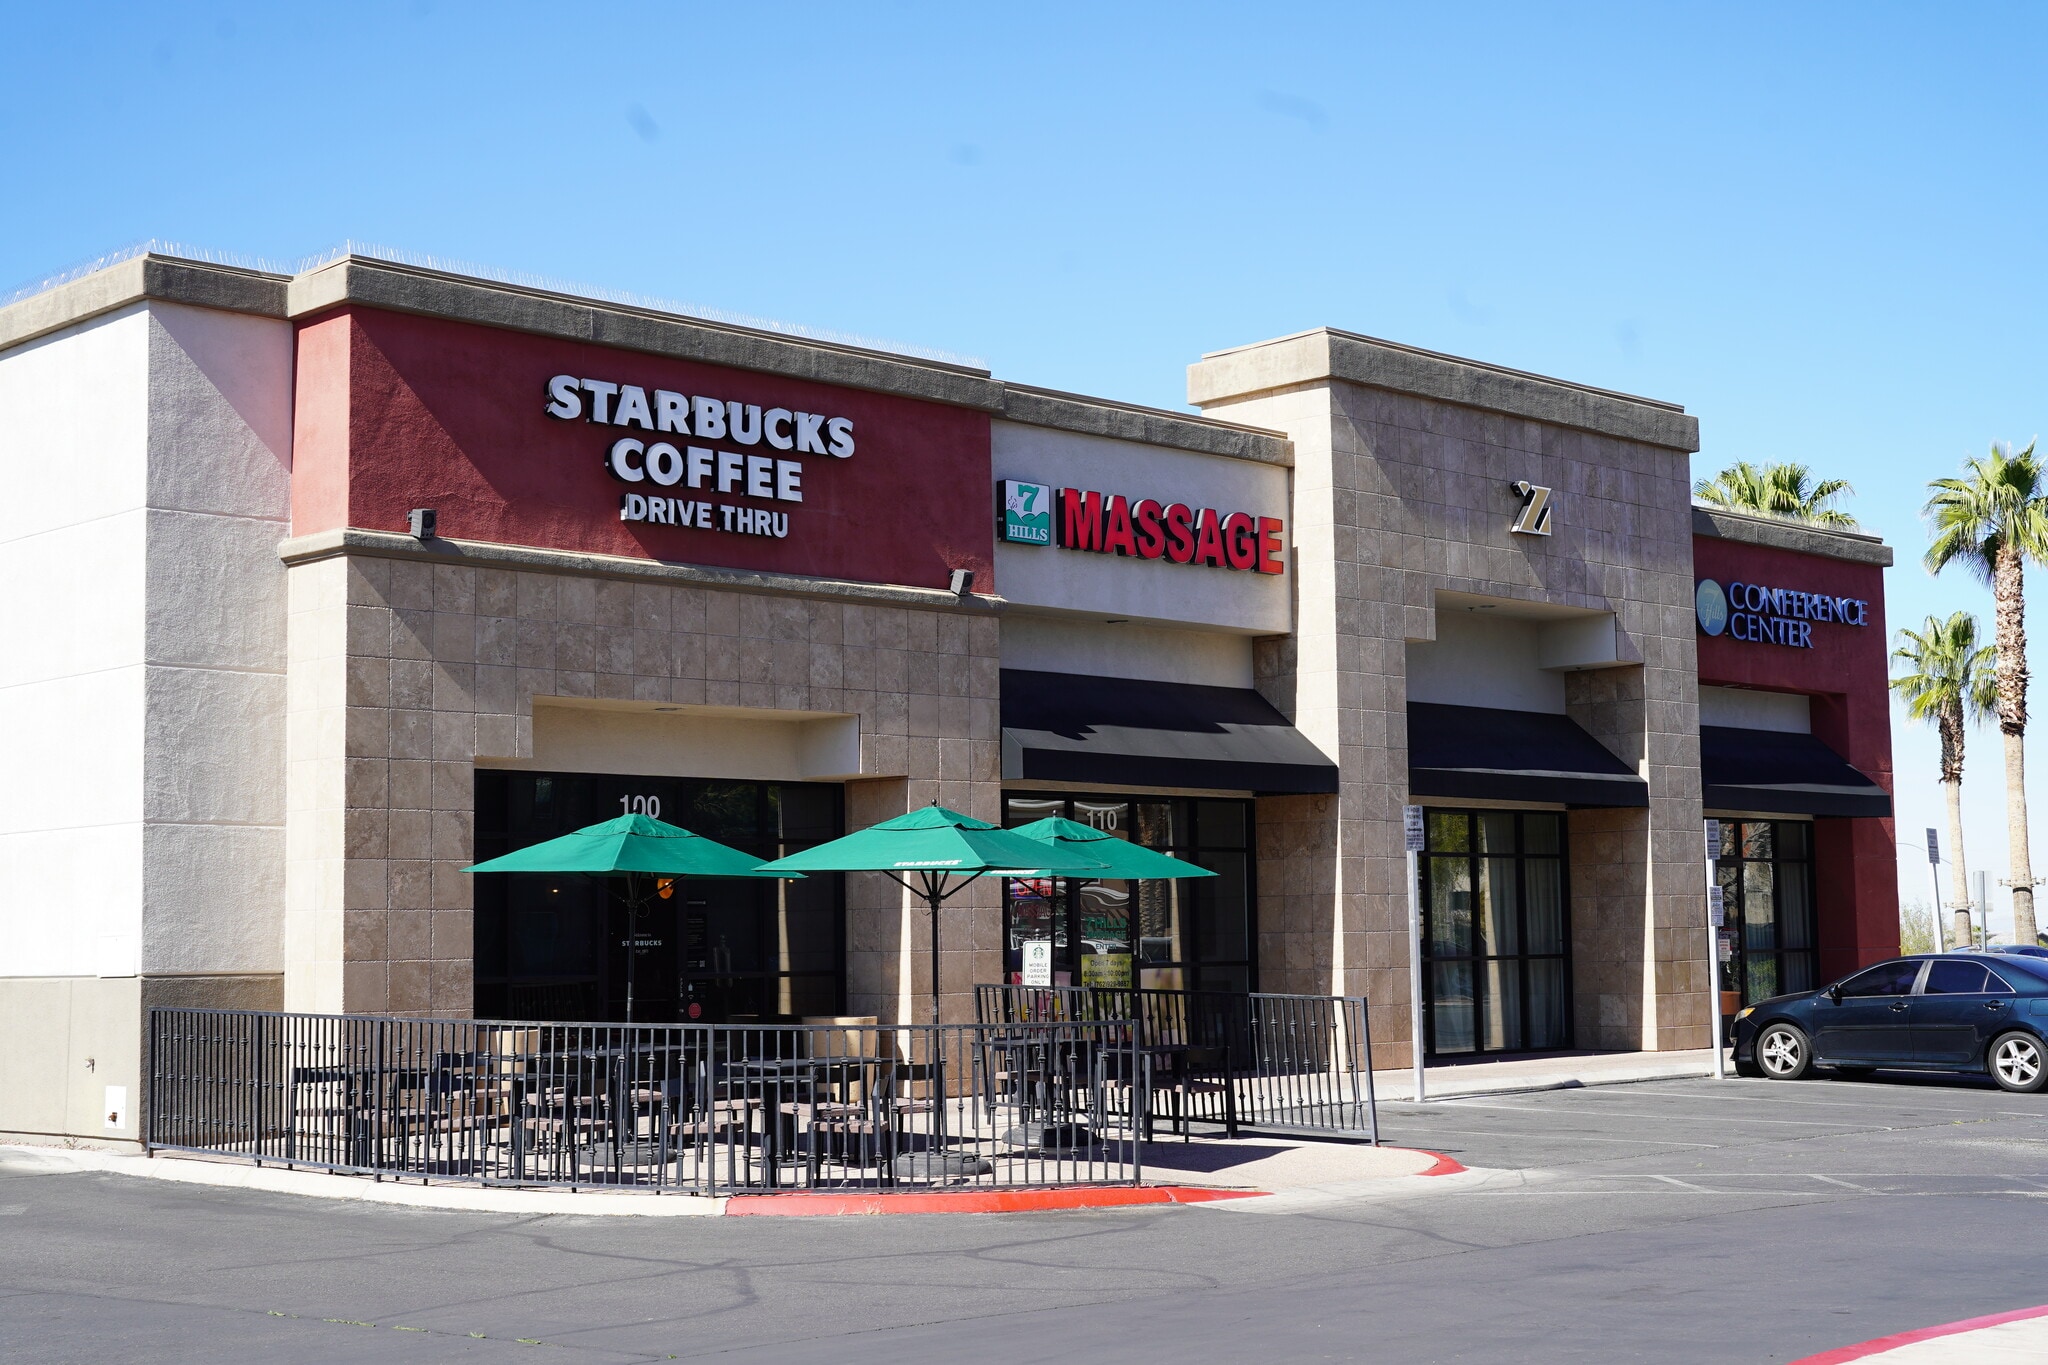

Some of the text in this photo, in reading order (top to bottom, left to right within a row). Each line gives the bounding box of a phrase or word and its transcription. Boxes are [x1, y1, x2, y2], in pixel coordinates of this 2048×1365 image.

[548, 374, 856, 459] STARBUCKS
[609, 437, 803, 503] COFFEE
[623, 493, 789, 539] DRIVE THRU
[1017, 484, 1040, 512] 7
[1008, 523, 1048, 542] HILLS
[1062, 487, 1284, 575] MASSAGE
[1729, 581, 1869, 627] CONFERENCE
[1730, 612, 1814, 649] CENTER
[619, 794, 661, 819] 100
[1086, 809, 1118, 830] 110
